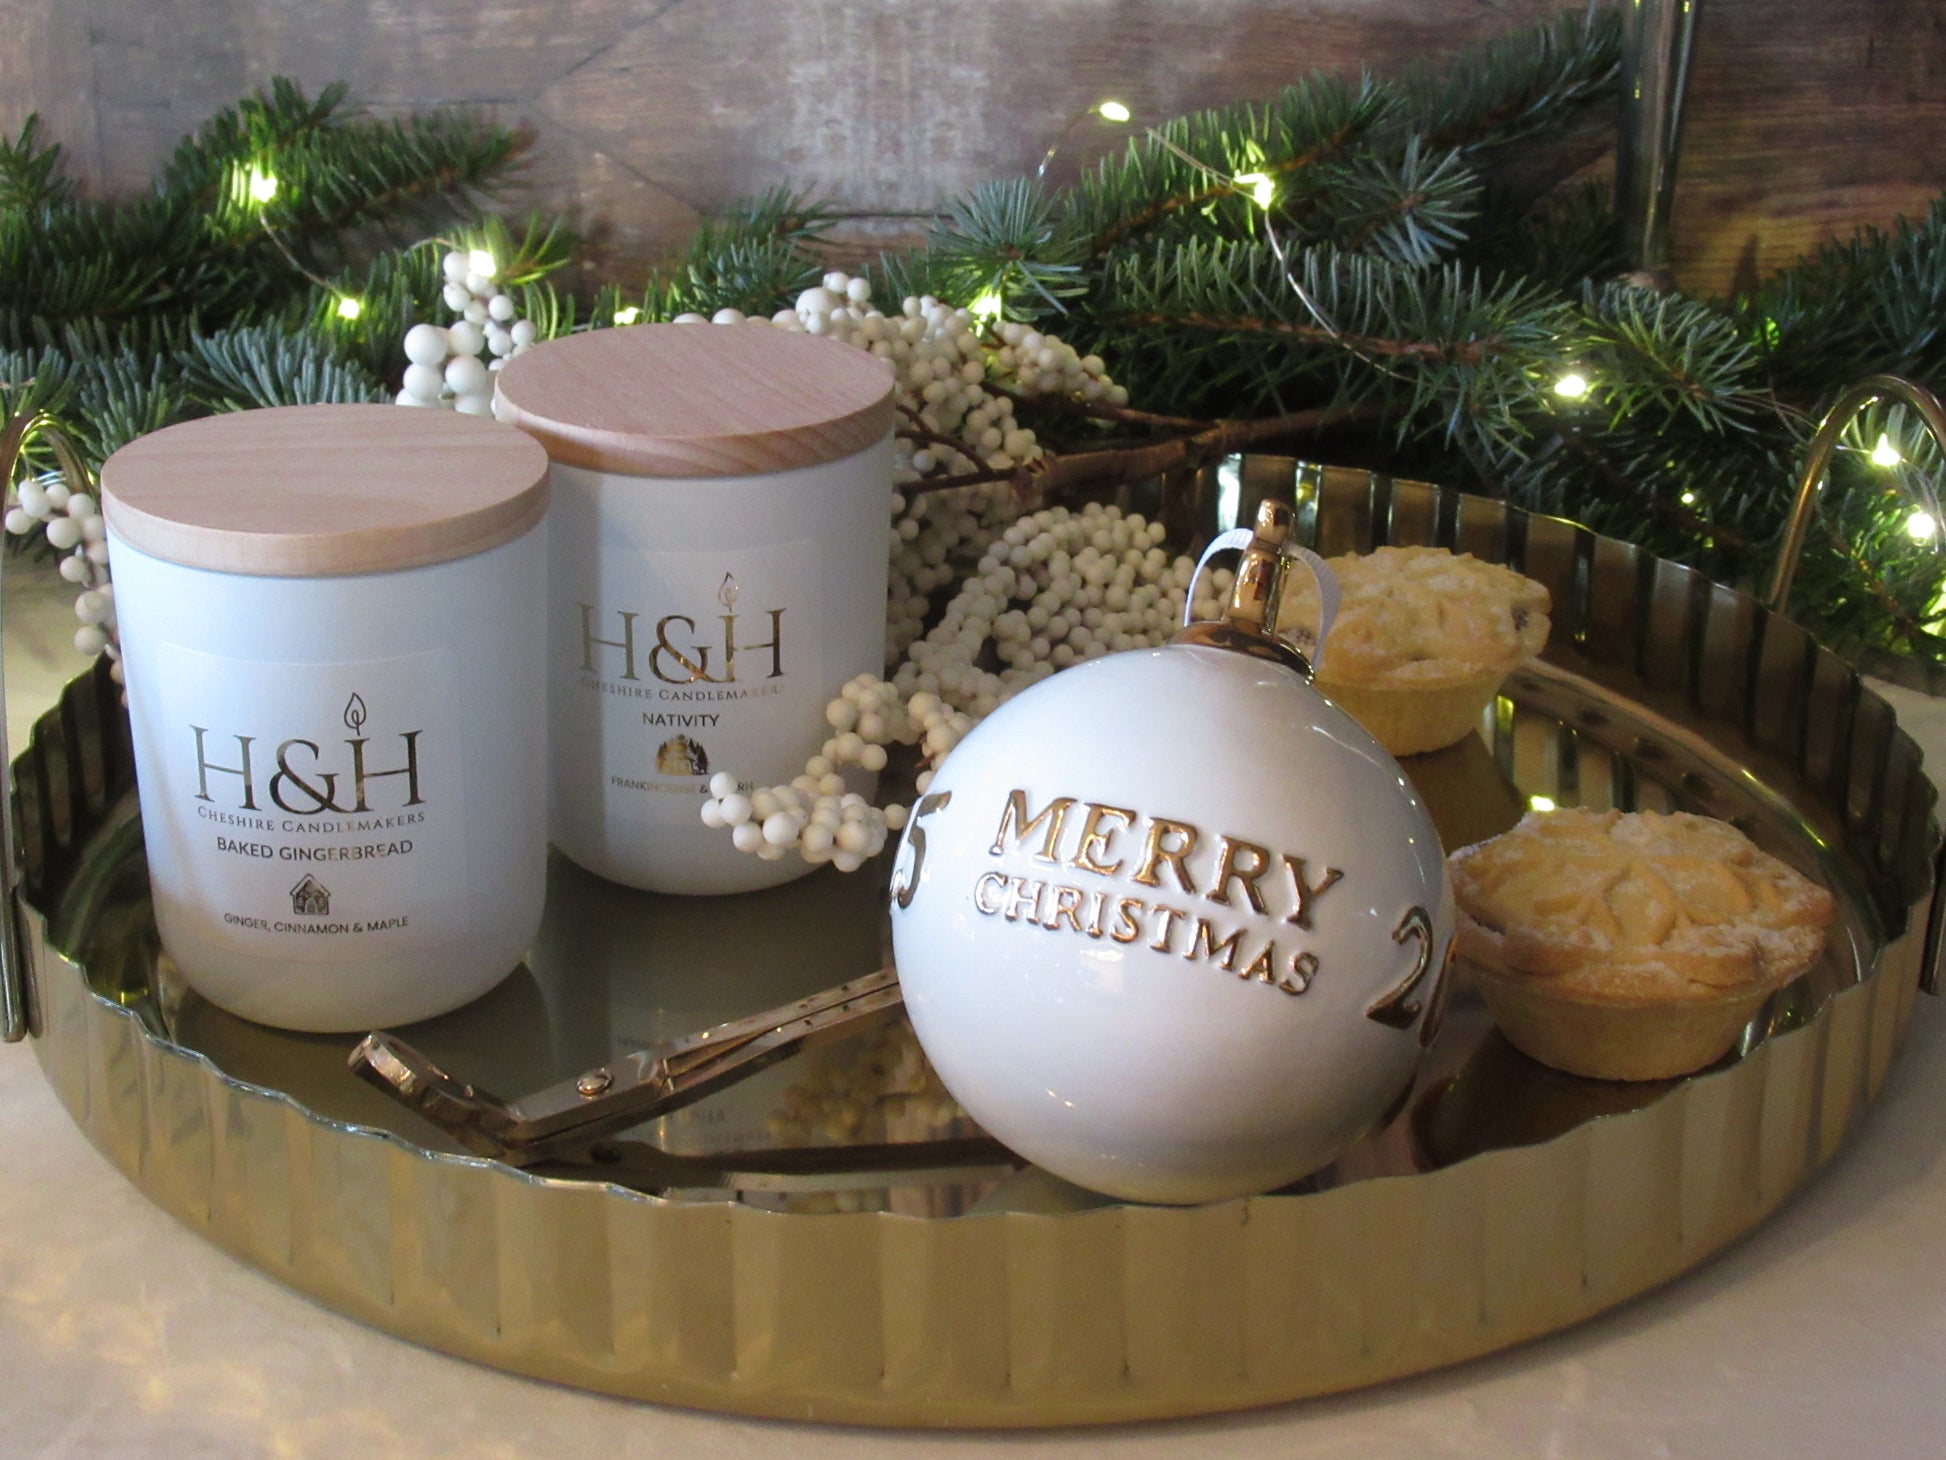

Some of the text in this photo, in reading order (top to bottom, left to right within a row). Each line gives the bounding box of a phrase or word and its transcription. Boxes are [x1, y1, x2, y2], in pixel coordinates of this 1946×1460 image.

[578, 602, 787, 685] H&H
[642, 712, 720, 727] NATIVITY
[189, 724, 426, 815] H&H
[197, 805, 426, 834] CHESHIRE CANDLEMAKERS
[216, 836, 414, 862] BAKED GINGERBREAD
[988, 788, 1344, 931] MERRY
[223, 913, 410, 934] GINGER, CINNAMON & MAPLE
[974, 871, 1320, 997] CHRISTMAS
